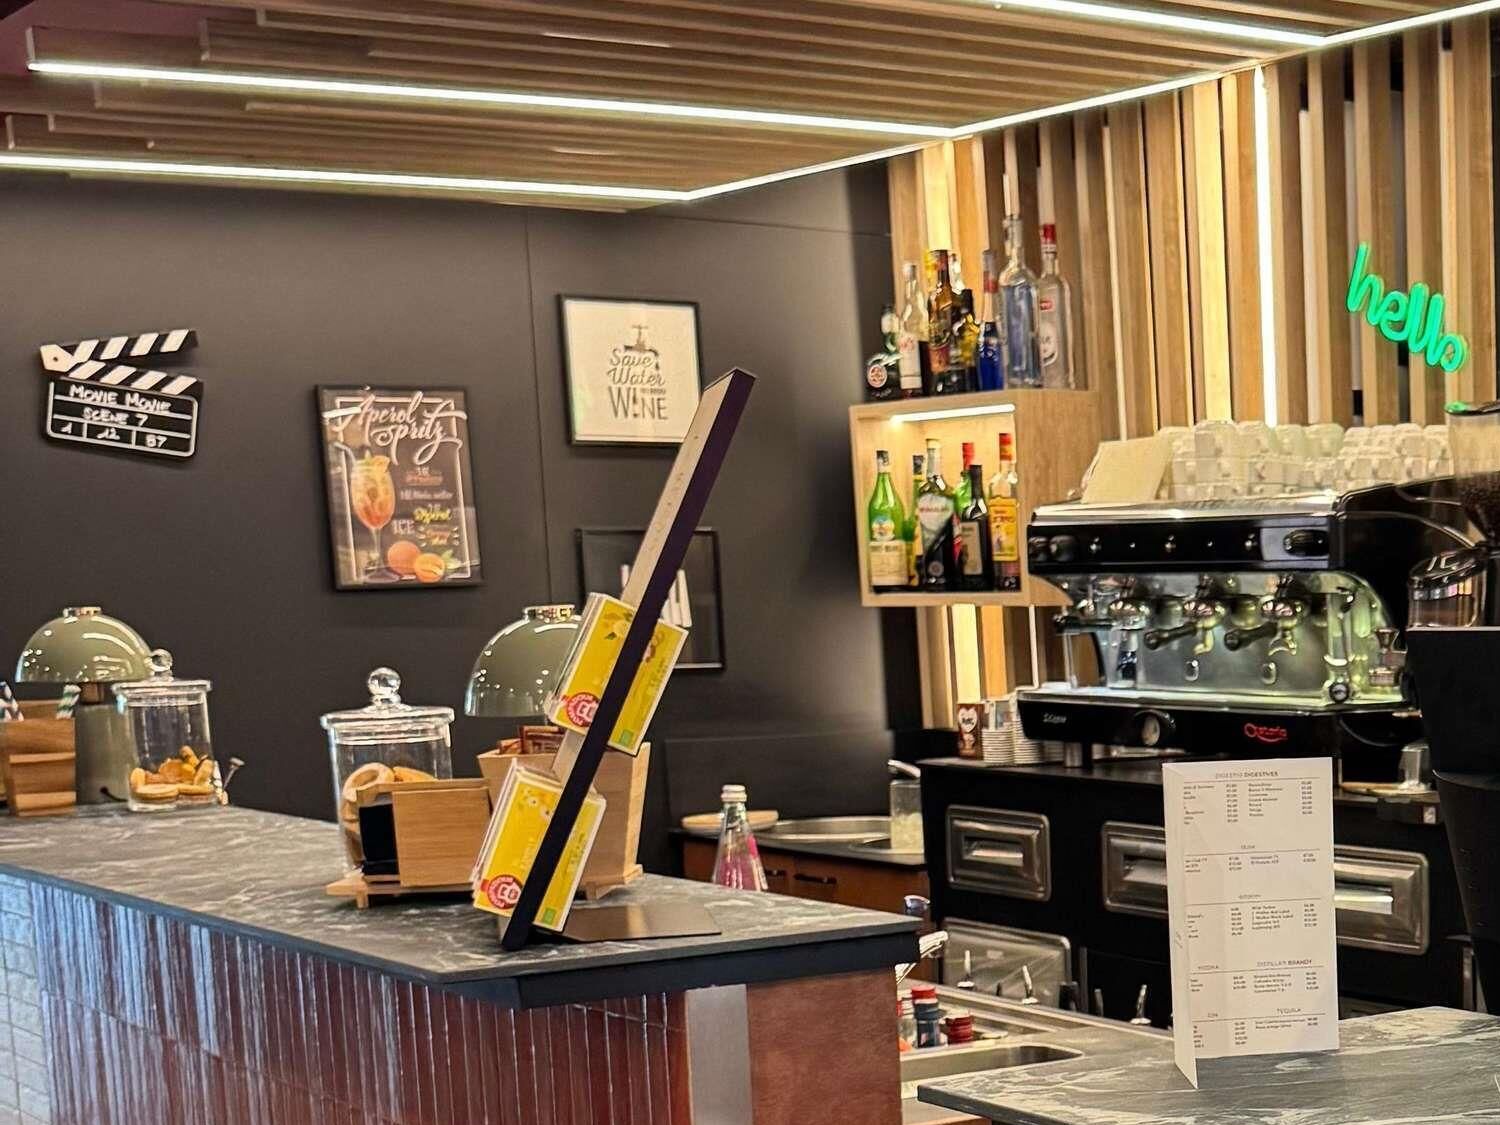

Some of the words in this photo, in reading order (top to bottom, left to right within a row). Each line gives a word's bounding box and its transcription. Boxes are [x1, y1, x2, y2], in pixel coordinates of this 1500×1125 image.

[1346, 241, 1468, 373] hello
[609, 348, 654, 367] Save
[606, 367, 666, 386] Water
[69, 384, 119, 405] MOVIE
[125, 392, 172, 413] MOVIE
[83, 407, 130, 425] SCENE
[135, 414, 149, 427] 7
[322, 390, 425, 447] Aperol
